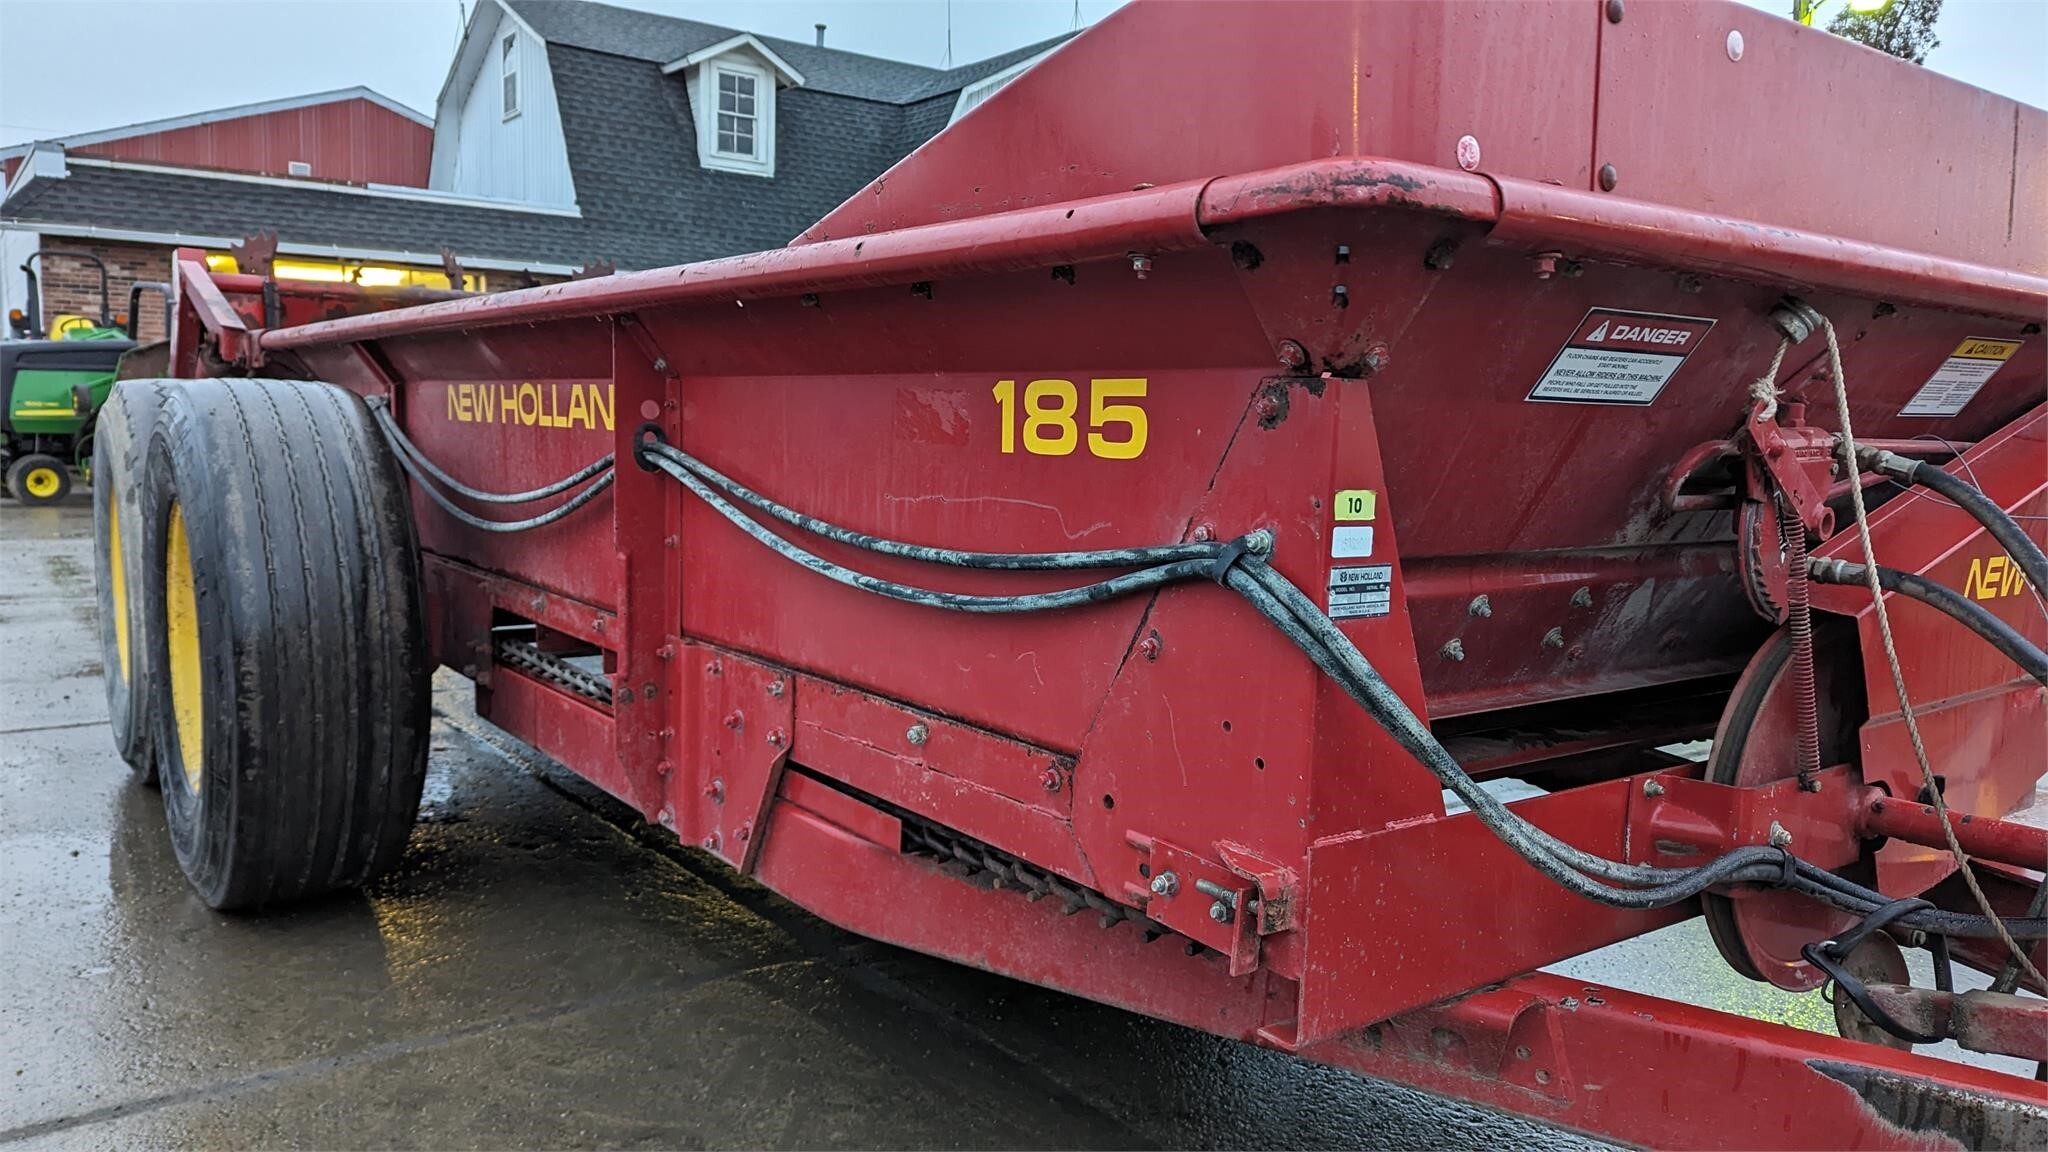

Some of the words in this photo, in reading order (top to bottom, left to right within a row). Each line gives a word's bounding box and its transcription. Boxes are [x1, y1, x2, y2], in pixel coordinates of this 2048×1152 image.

[1610, 325, 1692, 345] DANGER
[1974, 344, 2007, 355] CAUTION
[1554, 369, 1576, 377] NEVER
[1575, 370, 1594, 378] ALLOW
[1594, 371, 1616, 379] RIDERS
[1639, 374, 1663, 382] MACHINE
[448, 384, 495, 423] NEW
[501, 382, 615, 431] HOLLAN
[992, 378, 1148, 459] 185
[1348, 498, 1362, 513] 10
[1348, 573, 1359, 581] NEW
[1361, 572, 1383, 580] HOLLAND
[1964, 556, 2025, 599] NEW
